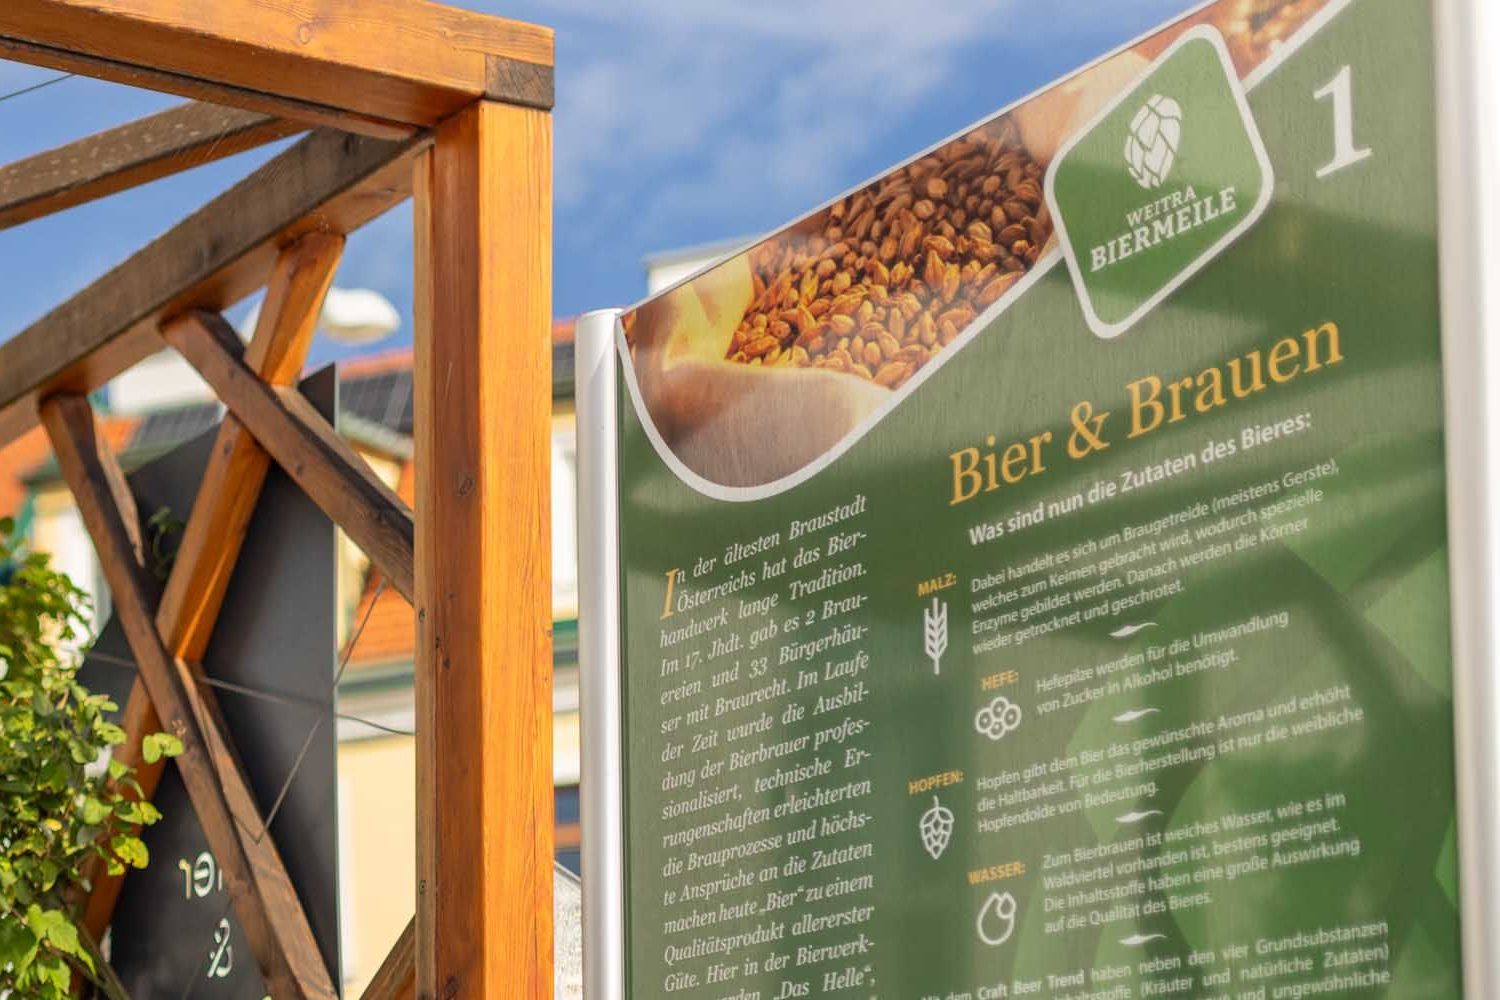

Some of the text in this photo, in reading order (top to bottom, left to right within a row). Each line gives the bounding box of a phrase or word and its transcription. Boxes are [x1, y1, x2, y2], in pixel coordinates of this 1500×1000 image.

[1312, 64, 1373, 178] 1
[1090, 186, 1237, 272] BIERMEILE
[1125, 185, 1197, 228] WEITRA
[949, 320, 1343, 505] Bier & Brauen
[968, 411, 1311, 546] Was sind nun die Zutaten des Bieres:
[676, 530, 867, 612] Österreichs hat das Bier-
[692, 556, 717, 578] der
[723, 531, 780, 566] ältesten
[788, 493, 866, 540] Braustadt
[970, 568, 1006, 593] Dabei
[1006, 552, 1055, 581] handelt
[1053, 549, 1070, 565] es
[1071, 539, 1097, 559] sich
[1098, 533, 1121, 550] um
[1122, 501, 1209, 542] Braugetreide
[1210, 479, 1280, 514] (meistens
[970, 588, 1019, 614] welches
[1019, 579, 1048, 598] zum
[1048, 563, 1097, 588] Keimen
[1097, 540, 1157, 575] gebracht
[1194, 507, 1257, 541] wodurch
[1259, 487, 1323, 520] spezielle
[659, 562, 867, 648] handwerk lange Tradition.
[916, 571, 956, 597] MALZ:
[659, 593, 868, 677] Im 17. Jhdt. gab es 2 Brau-
[659, 622, 869, 705] ereien und 33 Bürgerhäu-
[1094, 652, 1145, 677] werden
[1145, 644, 1167, 662] für
[1167, 638, 1190, 656] die
[1191, 611, 1289, 649] Umwandlung
[660, 649, 869, 734] ser mit Braurecht. Im Laufe
[980, 669, 1019, 691] HEFE:
[660, 680, 869, 762] der Zeit wurde die Ausbil-
[660, 716, 870, 791] dung der Bierbrauer profes-
[976, 684, 1350, 791] Hopfen gibt dem Bier das gewünschte Aroma und erhöht
[661, 746, 871, 820] sionalisiert, technische Er-
[662, 779, 871, 848] rungenschaften erleichterten
[907, 769, 963, 794] HOPFEN:
[662, 809, 872, 877] die Brauprozesse und höchs-
[662, 842, 873, 906] te Ansprüche an die Zutaten
[966, 860, 1025, 885] WASSER:
[663, 908, 716, 934] machen
[717, 899, 758, 922] heute
[804, 885, 824, 902] zu
[824, 873, 873, 898] einem
[663, 904, 875, 966] Qualitätsprodukt allererster
[663, 932, 875, 992] Güte. Hier in der Bierwerk-
